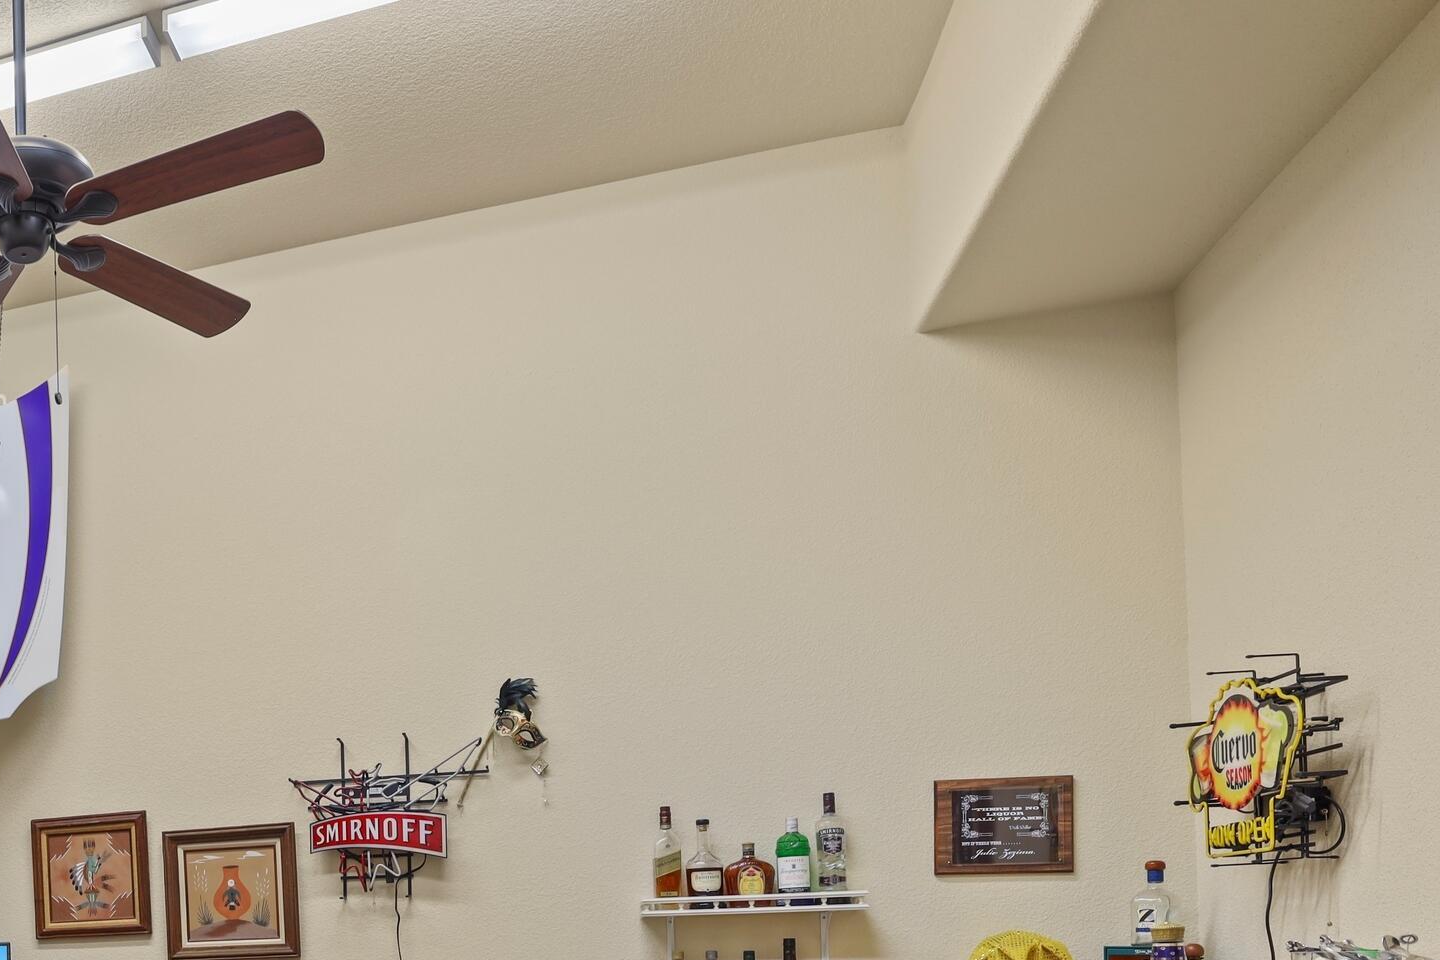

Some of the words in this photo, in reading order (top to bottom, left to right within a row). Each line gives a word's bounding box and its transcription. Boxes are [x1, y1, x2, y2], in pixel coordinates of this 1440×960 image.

[1211, 729, 1257, 773] Cuervo
[1225, 764, 1253, 790] SEASON
[316, 817, 434, 846] SMIRNOFF
[1209, 822, 1238, 850] NOW
[1237, 815, 1273, 847] OPEN
[1138, 908, 1155, 923] Z
